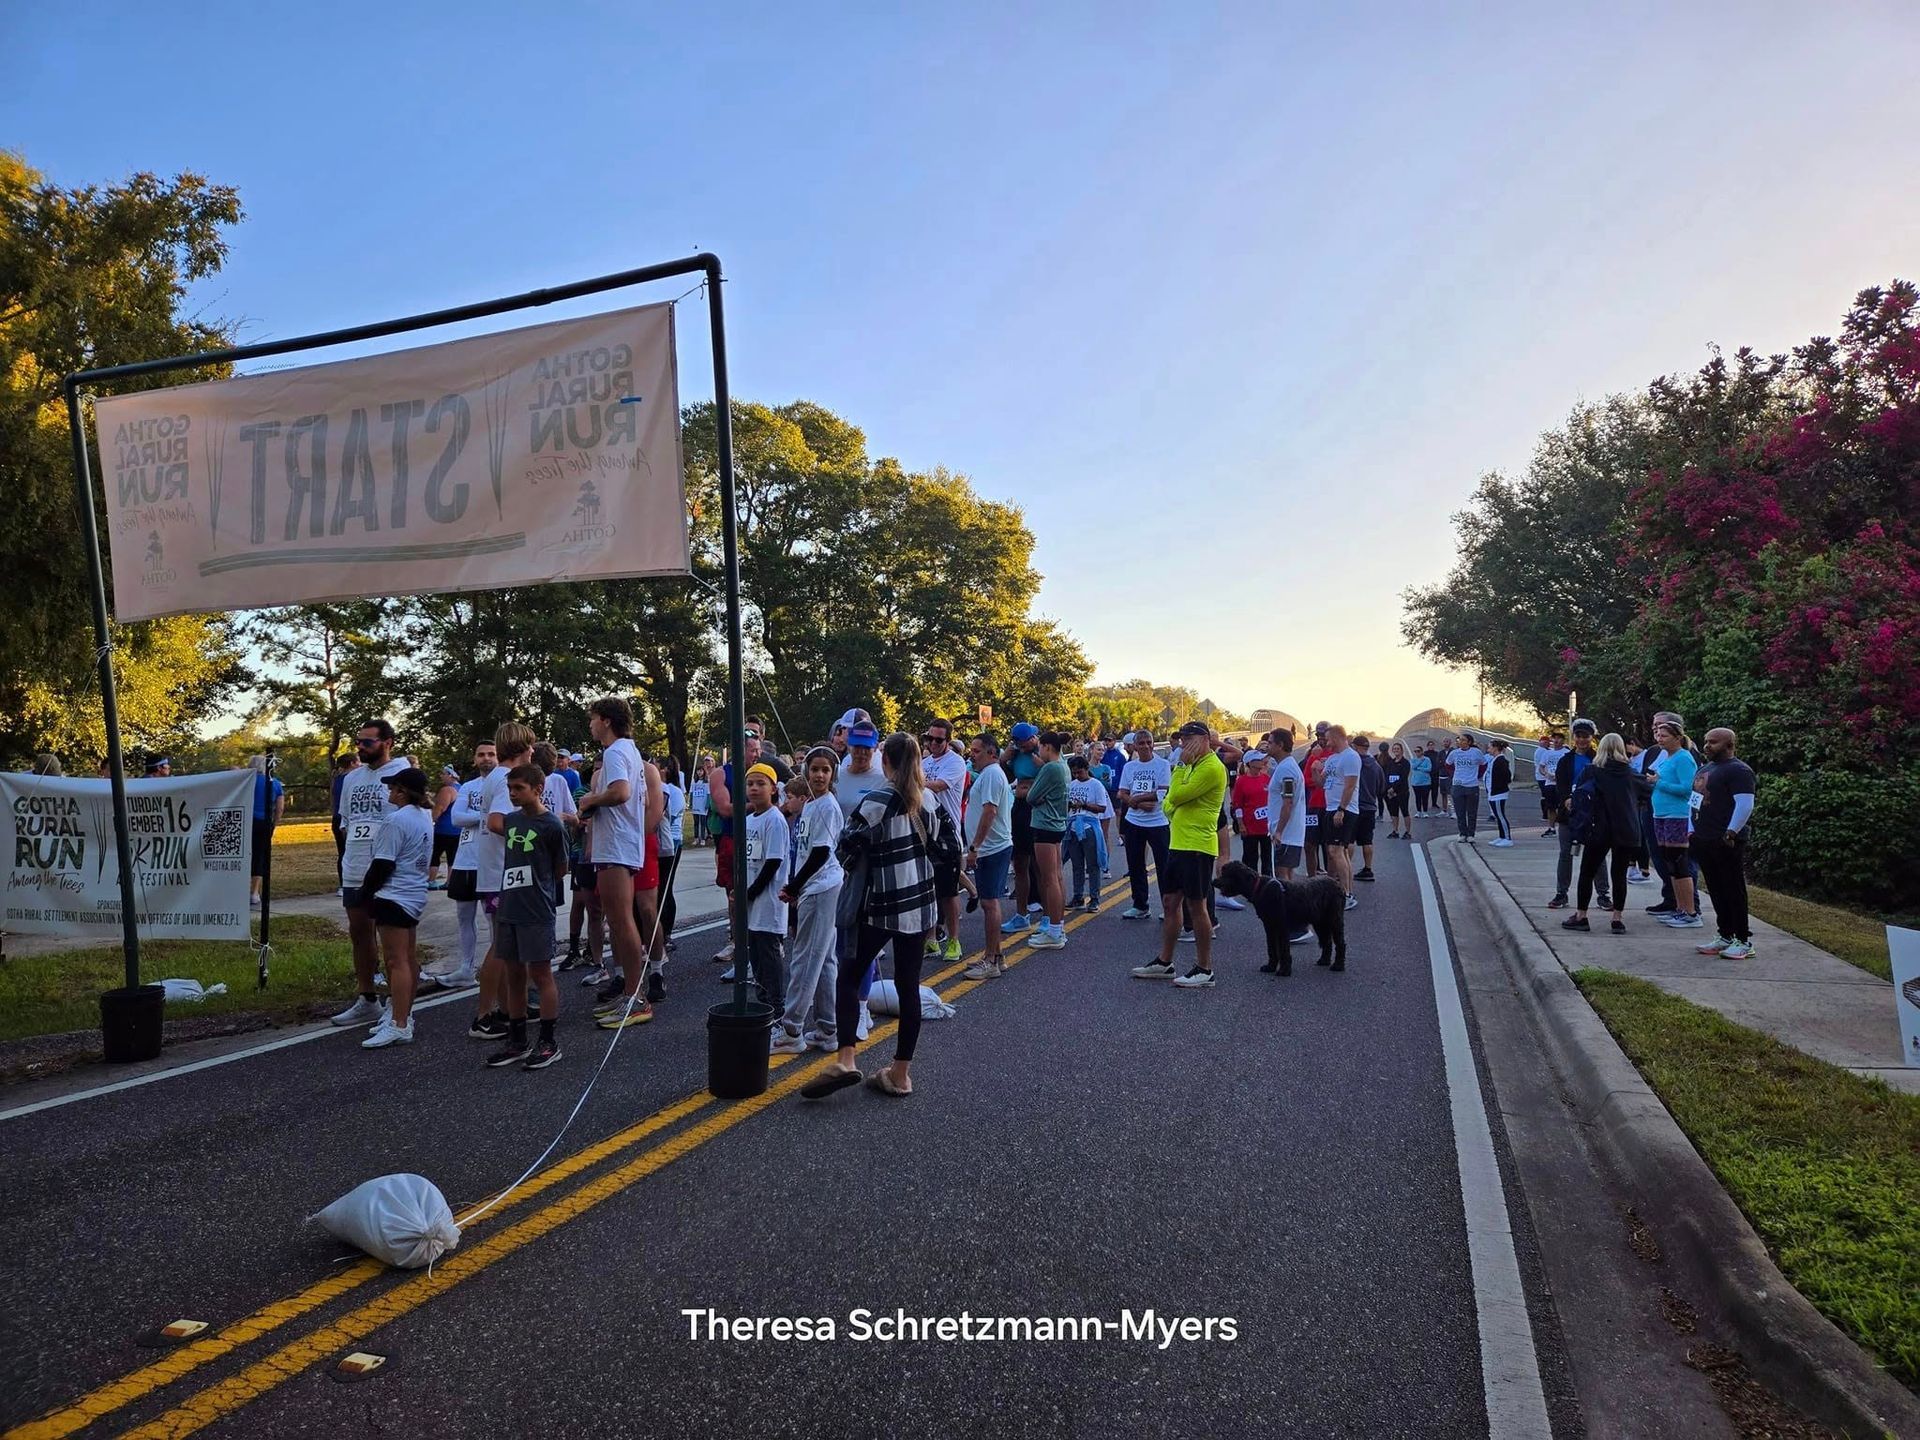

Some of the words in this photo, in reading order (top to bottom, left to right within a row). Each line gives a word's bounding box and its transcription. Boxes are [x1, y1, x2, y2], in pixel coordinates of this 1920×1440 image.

[1136, 781, 1149, 791] 38
[351, 792, 383, 801] RURAL
[13, 796, 82, 816] GOTHA
[126, 796, 163, 814] TURDAY
[163, 796, 192, 834] 16
[350, 801, 383, 814] RUN
[14, 815, 86, 837] RURAL
[128, 814, 165, 834] EMBER
[354, 825, 371, 838] 52
[15, 836, 86, 870] RUN
[129, 837, 151, 869] K
[150, 836, 191, 870] RUN
[204, 860, 242, 872] MYGOTHA.ORG
[7, 870, 43, 892] Among
[55, 872, 85, 893] Trees
[140, 872, 190, 887] FESTIVAL
[506, 870, 525, 887] 54
[6, 907, 23, 920] GOTHA
[24, 908, 42, 921] RURAL
[43, 909, 78, 922] SETTLEMENT
[78, 911, 116, 924] ASSOCIATION
[148, 912, 173, 925] OFFICES
[182, 912, 201, 925] DAVID
